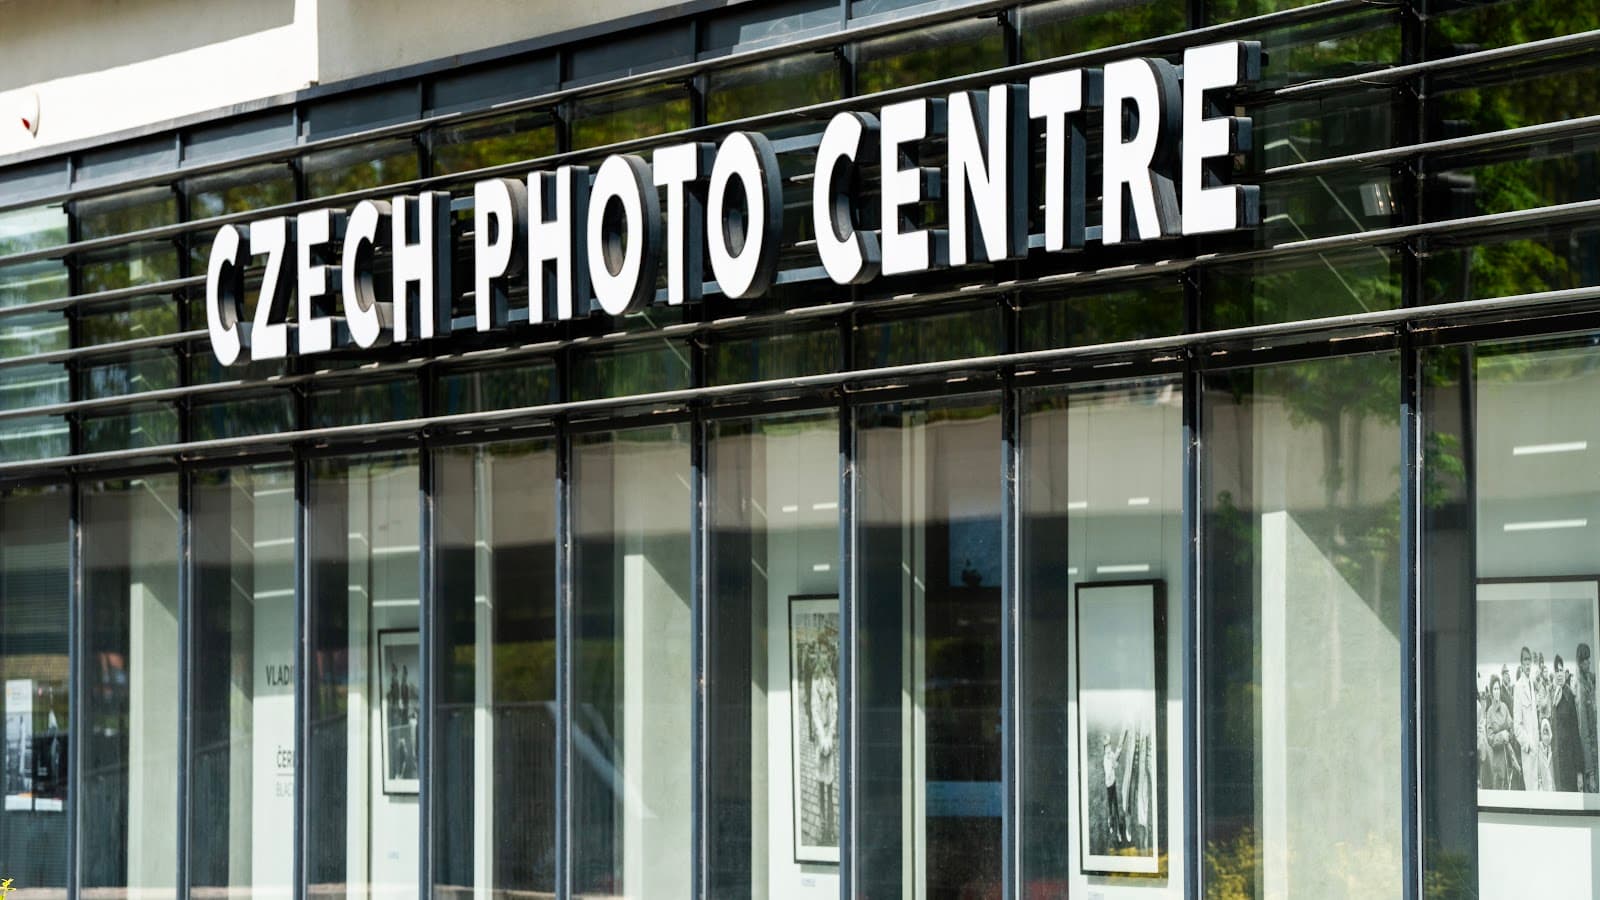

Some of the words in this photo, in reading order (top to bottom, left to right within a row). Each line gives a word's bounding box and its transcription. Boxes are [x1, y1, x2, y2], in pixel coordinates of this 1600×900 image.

[206, 191, 434, 366] CZECH
[474, 131, 764, 331] PHOTO
[813, 41, 1239, 285] CENTRE
